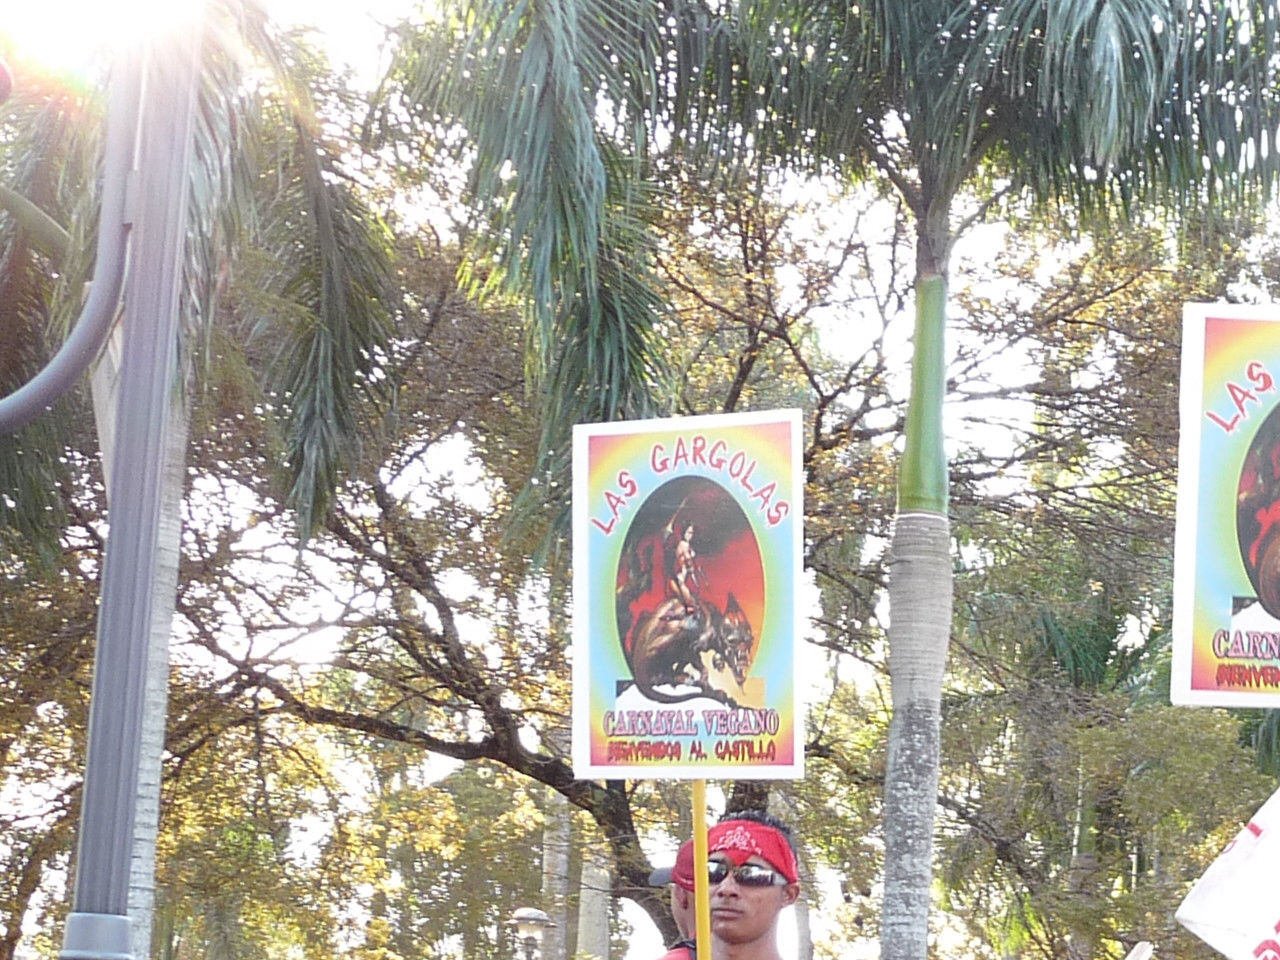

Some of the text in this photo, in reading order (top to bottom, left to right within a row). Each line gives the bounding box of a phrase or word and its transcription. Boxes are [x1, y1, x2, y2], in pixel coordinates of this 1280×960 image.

[1206, 361, 1275, 432] LAS
[591, 435, 789, 535] LAS GARGOLAS
[603, 708, 780, 736] CARNAVAL VEGANO
[607, 740, 776, 761] BIENVENIDOS AL CASTILLO
